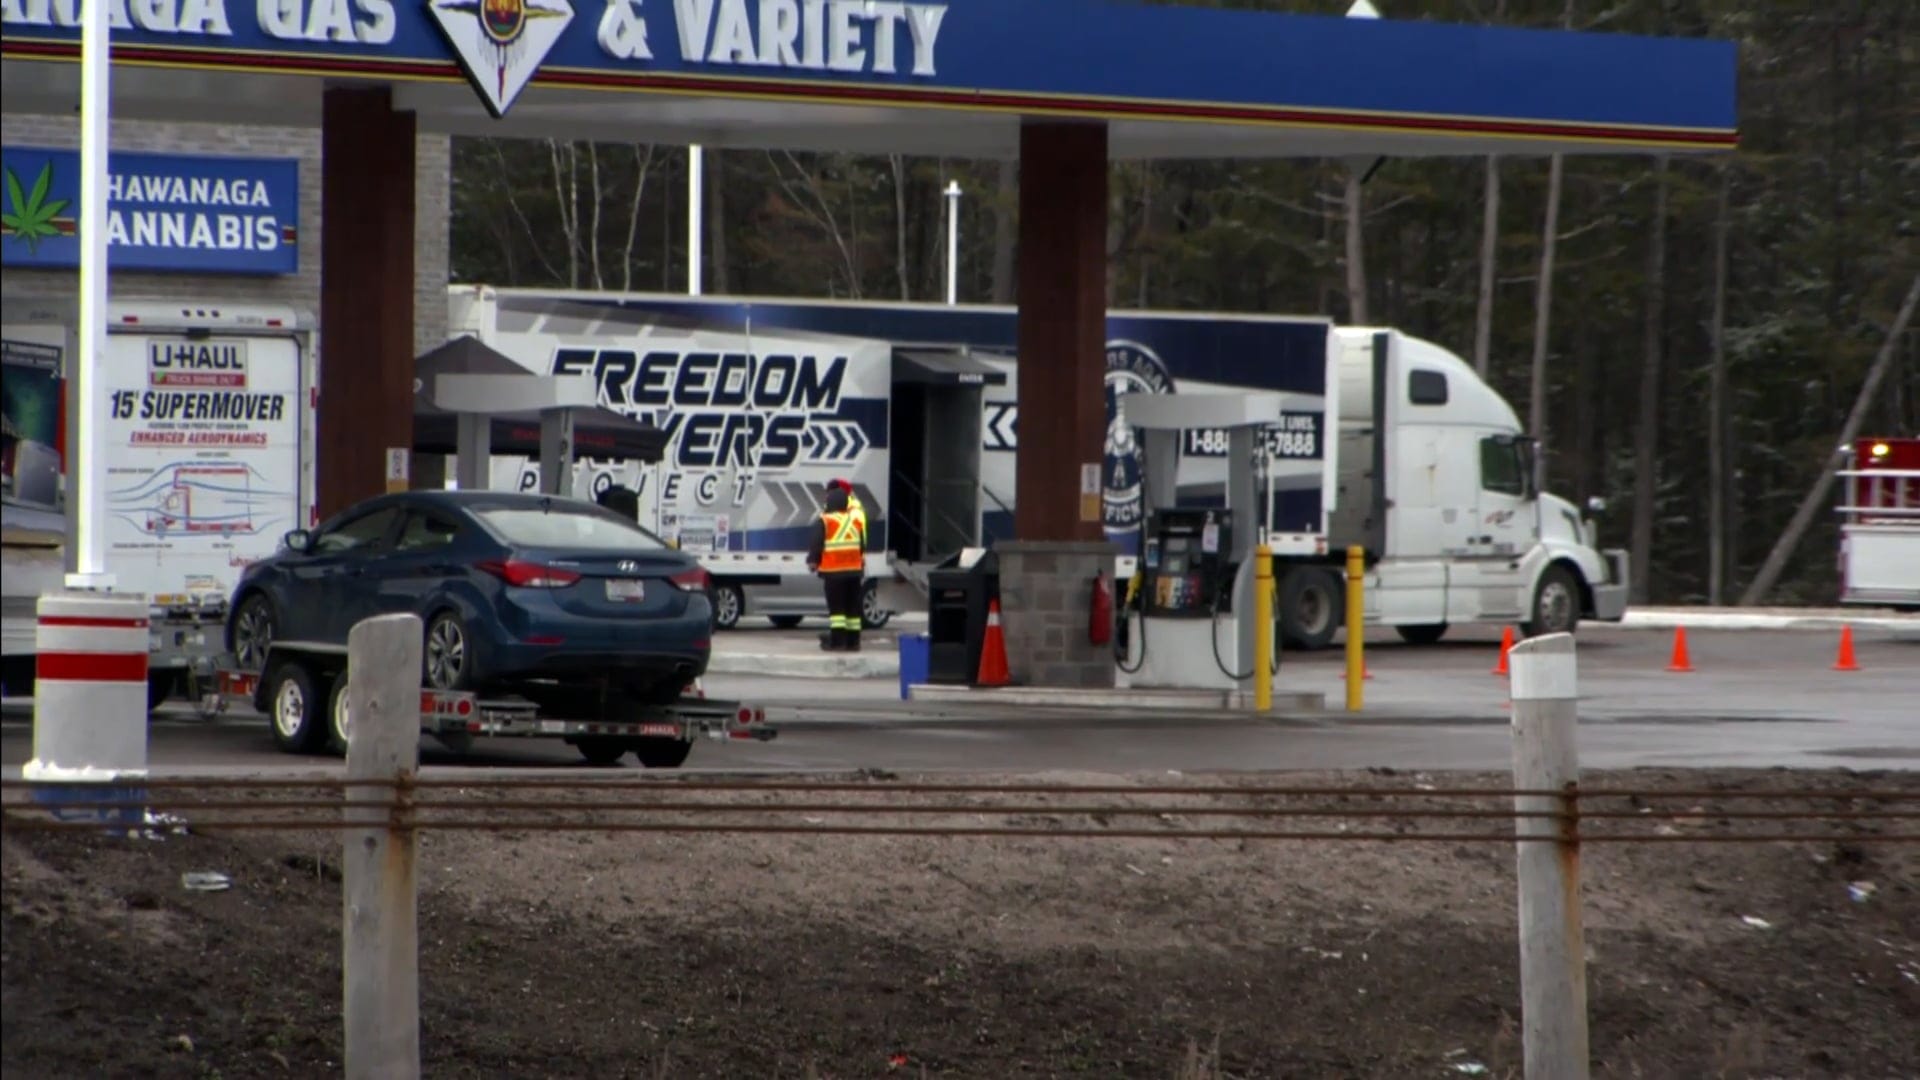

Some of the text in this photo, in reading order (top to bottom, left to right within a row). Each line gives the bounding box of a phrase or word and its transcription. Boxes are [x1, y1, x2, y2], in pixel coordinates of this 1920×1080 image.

[257, 0, 397, 44] GAS
[598, 0, 653, 59] &
[674, 0, 948, 76] VARIETY
[106, 174, 271, 207] HAWANAGA
[106, 211, 278, 251] ANNABIS
[152, 344, 243, 369] U-HAUL
[553, 349, 848, 409] FREEDOM
[130, 431, 186, 444] ENHANCED
[612, 411, 807, 468] VERS
[520, 471, 753, 502] POJECT
